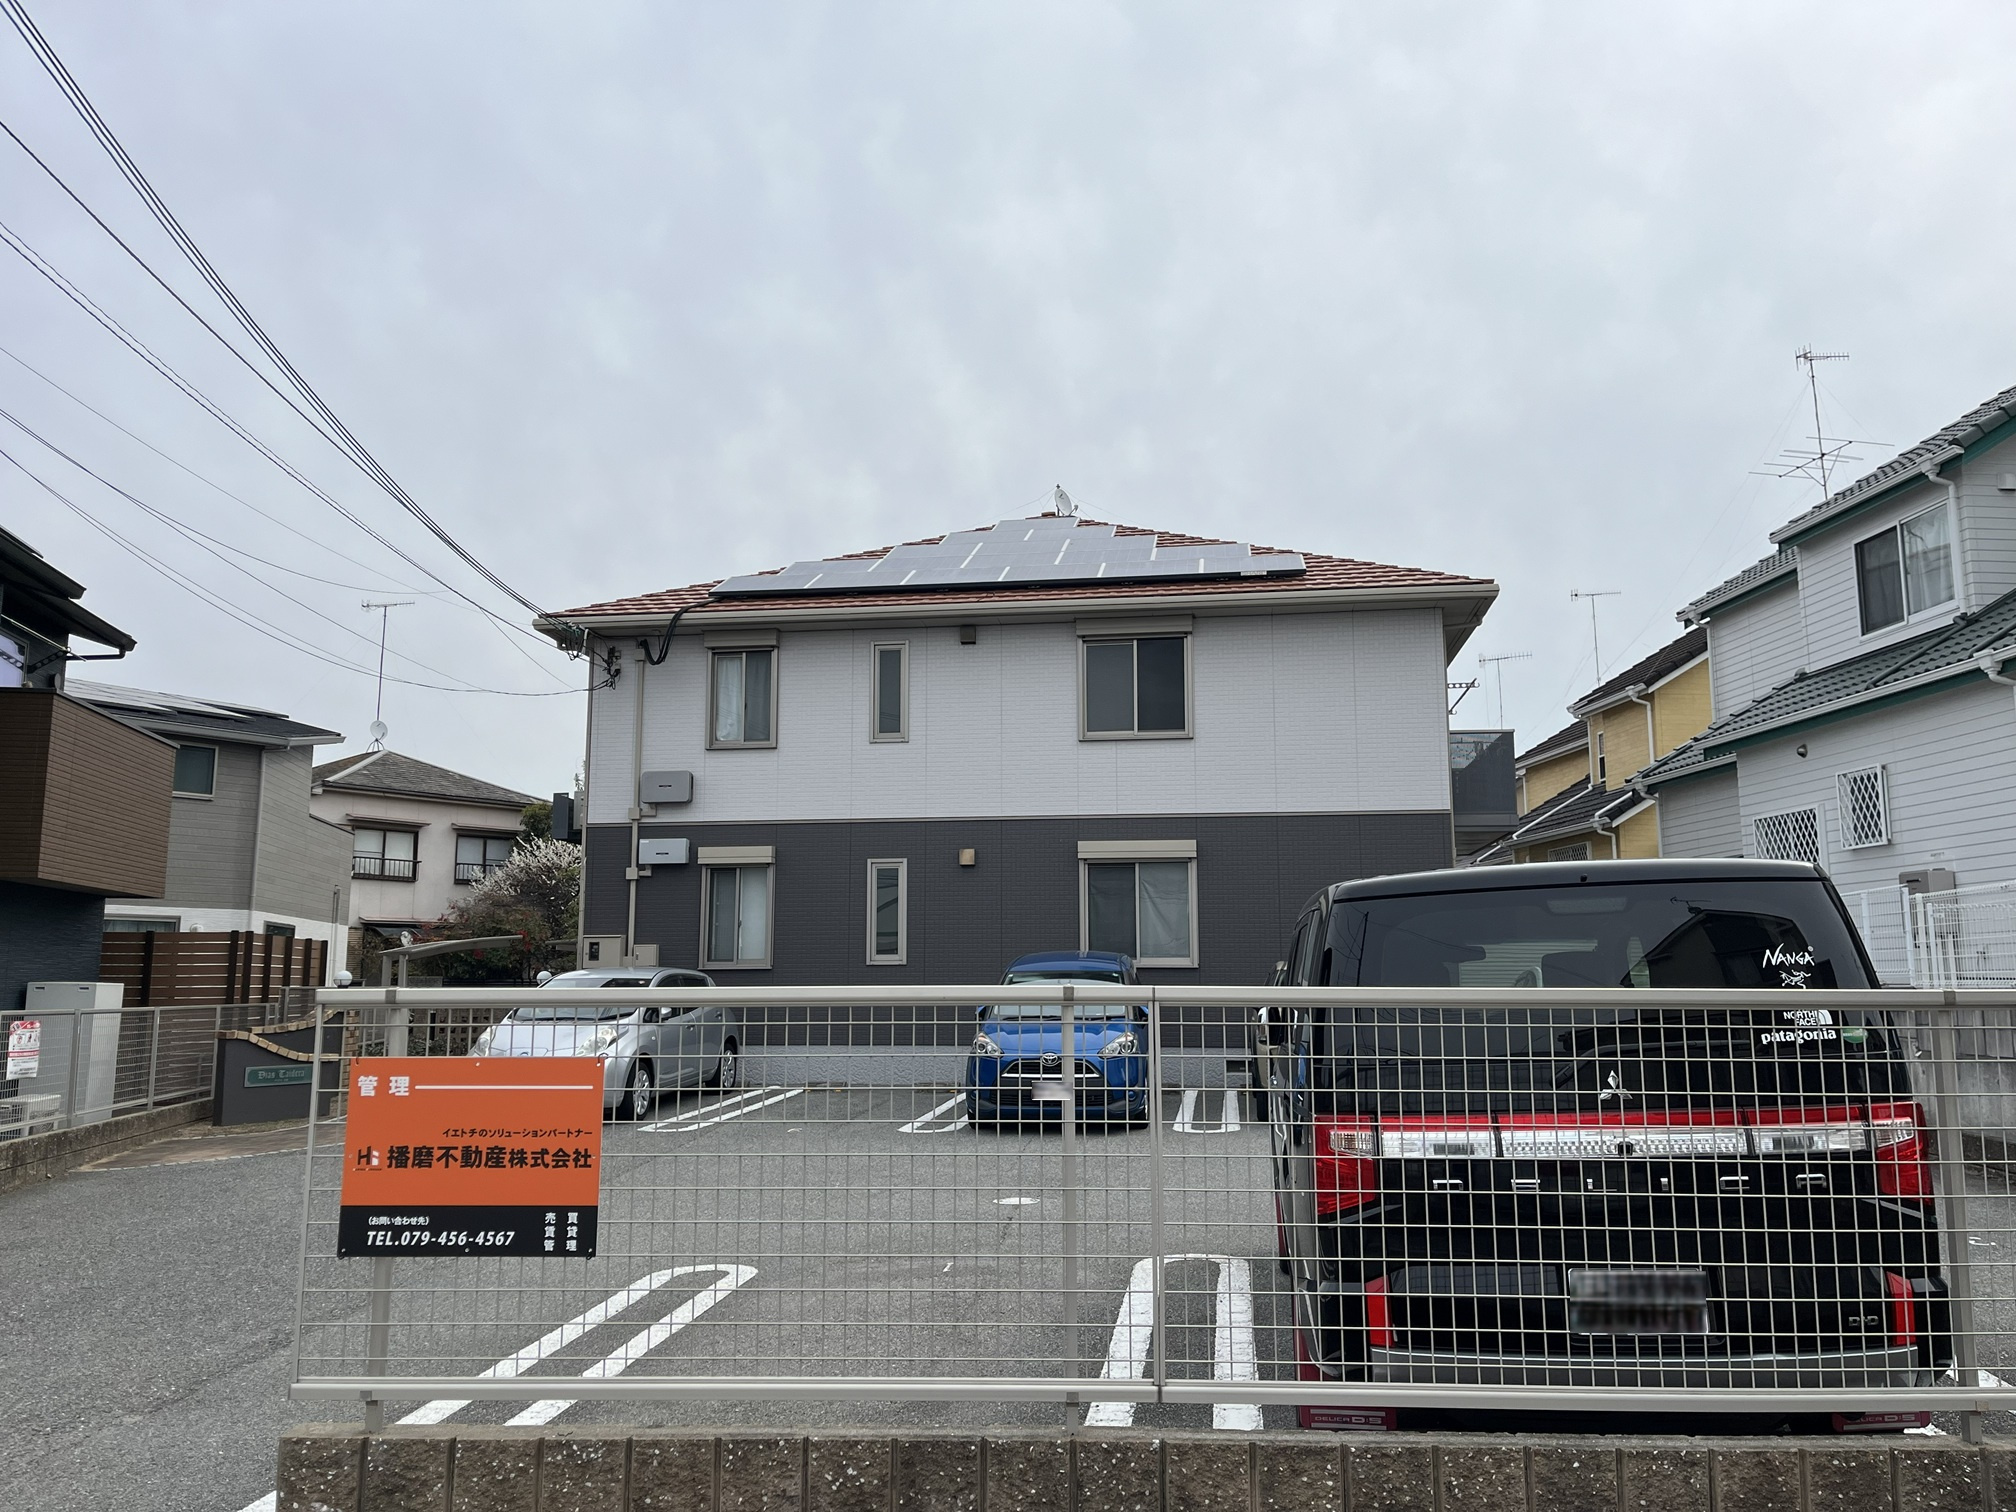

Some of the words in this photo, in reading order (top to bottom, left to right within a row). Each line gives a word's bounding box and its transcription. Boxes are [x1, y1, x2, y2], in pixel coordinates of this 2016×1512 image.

[1762, 943, 1815, 968] NANGA
[1796, 1018, 1817, 1026] FACE
[1761, 1028, 1837, 1045] patagonia
[358, 1075, 410, 1097] 管理
[386, 1145, 592, 1169] 播磨不動産株式会社
